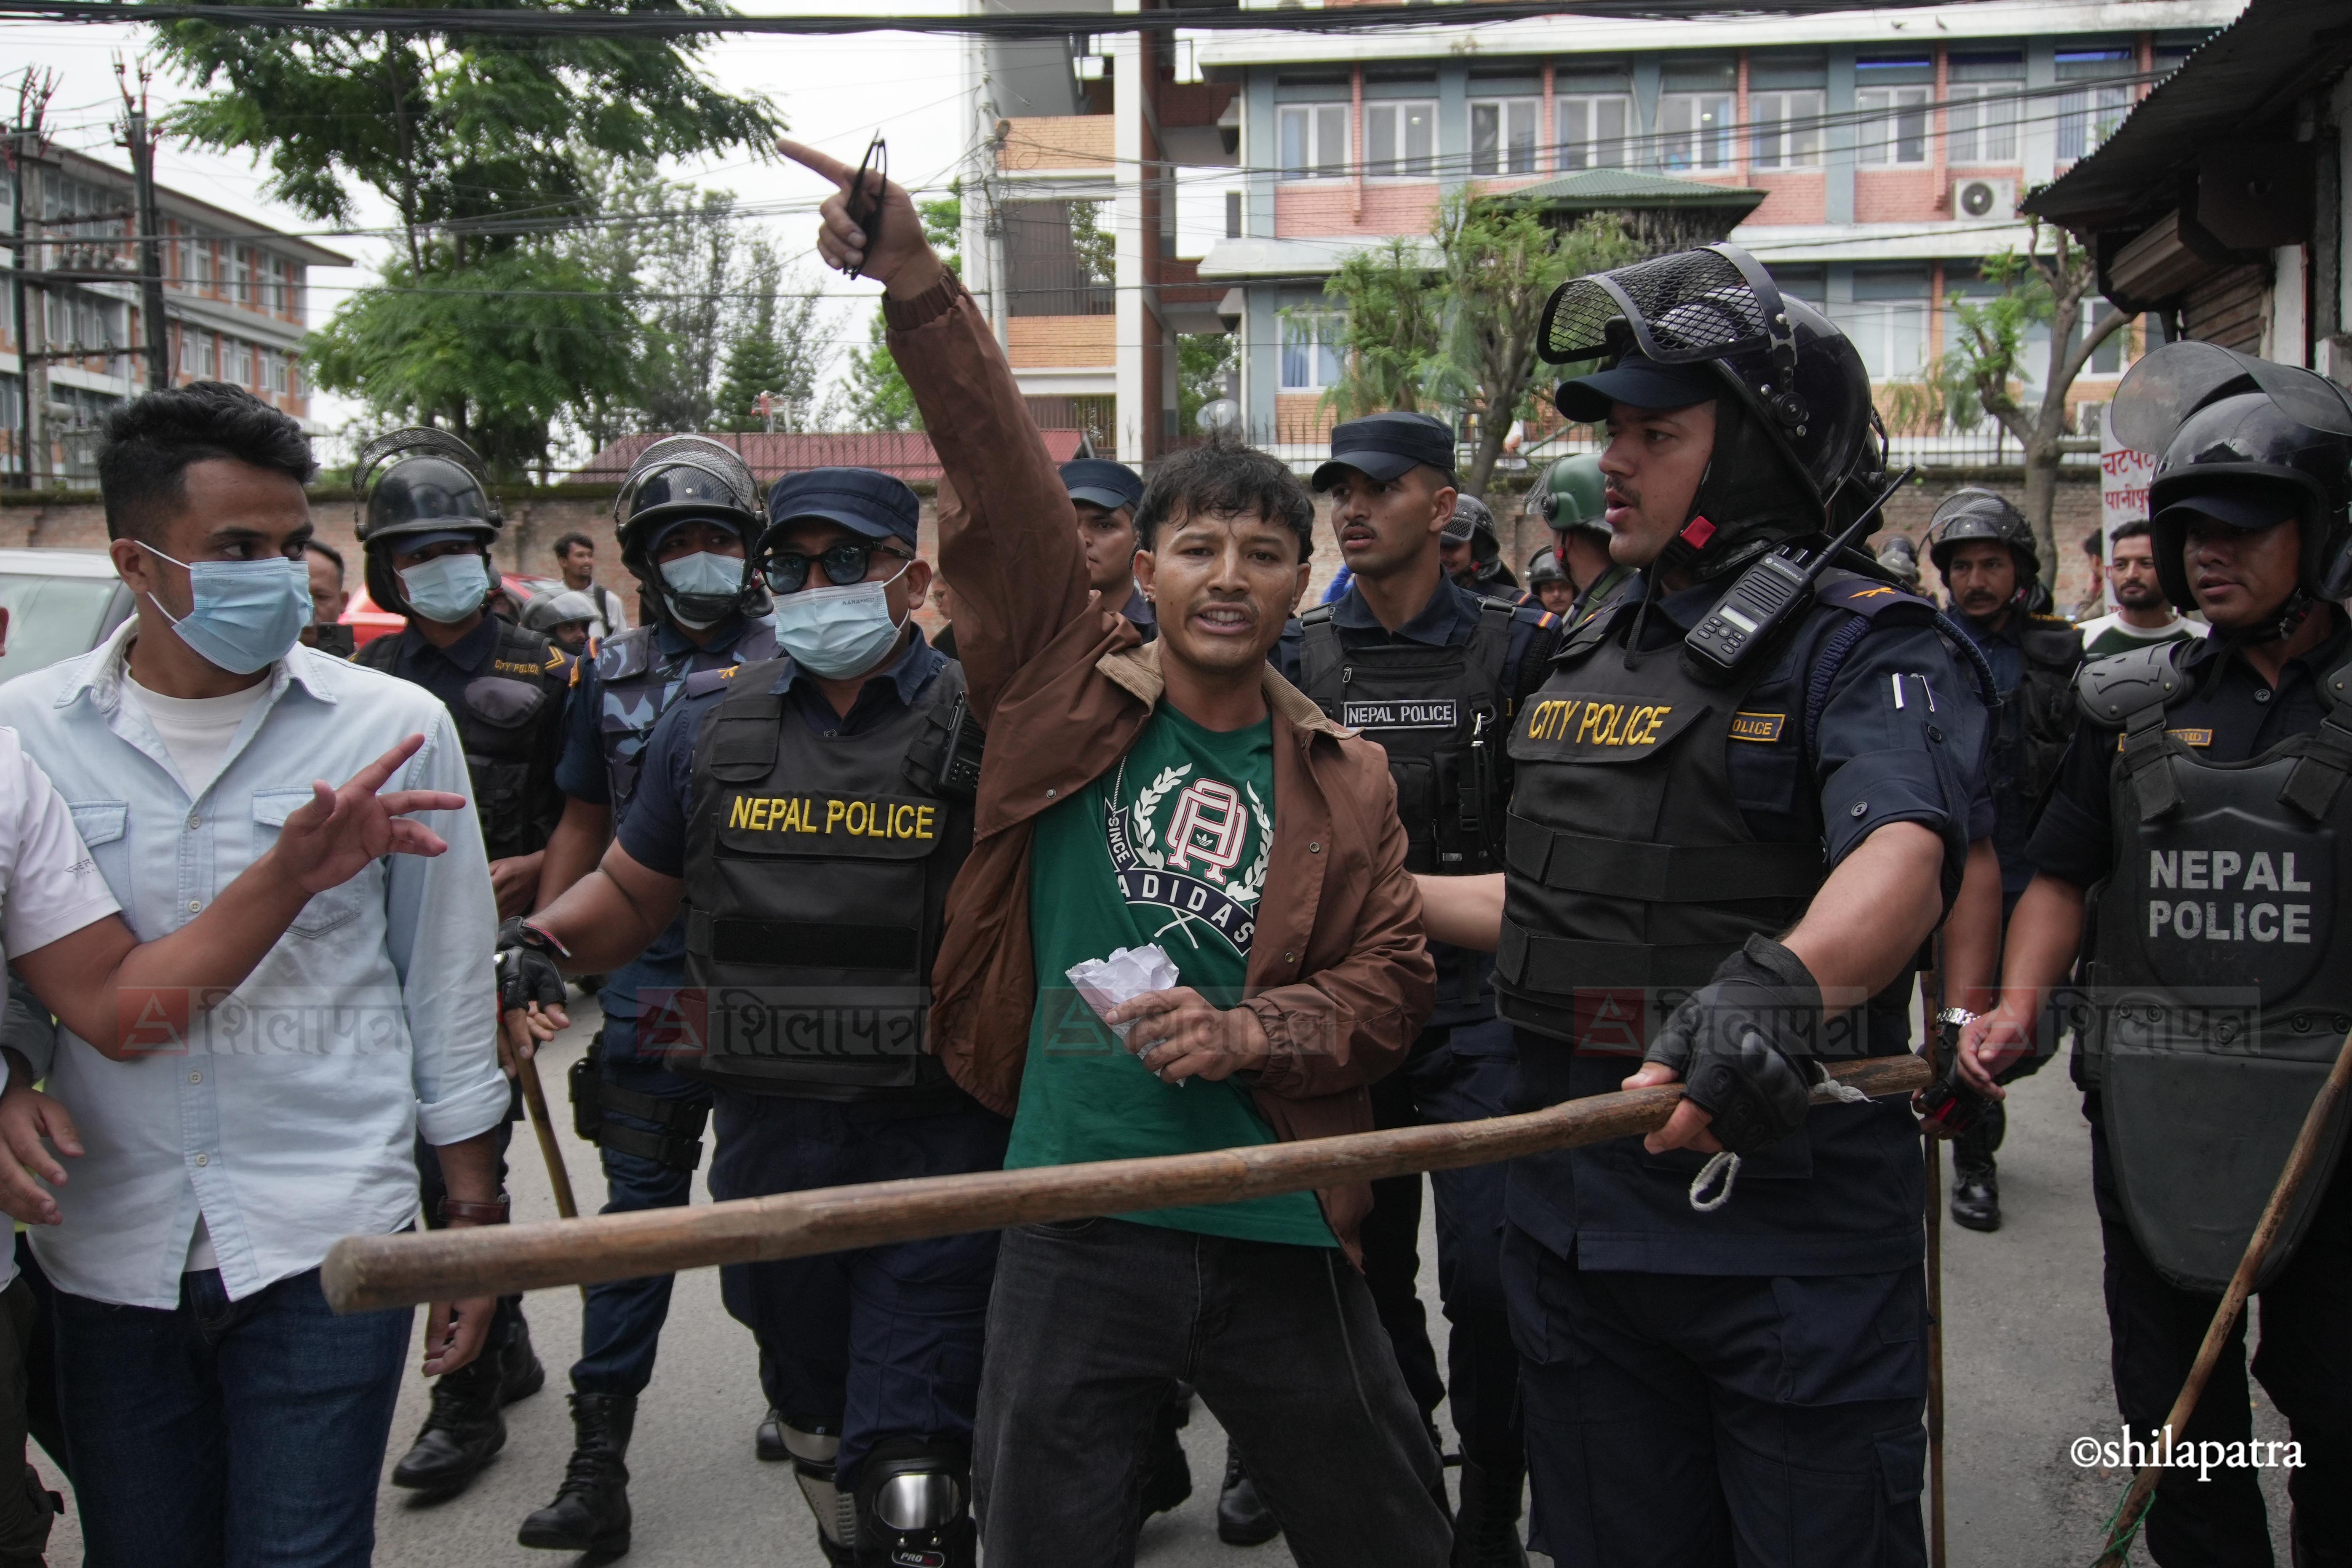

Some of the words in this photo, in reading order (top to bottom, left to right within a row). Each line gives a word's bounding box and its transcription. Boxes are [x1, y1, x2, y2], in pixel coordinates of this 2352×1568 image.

[1773, 562, 1802, 582] MOTOROLA
[495, 660, 511, 671] CITY
[513, 663, 539, 675] POLICE
[1348, 707, 1395, 724] NEPAL
[1400, 705, 1452, 722] POLICE
[1528, 700, 1582, 740] CITY
[1575, 702, 1672, 745] POLICE
[1732, 719, 1773, 735] OLICE
[729, 796, 817, 833] NEPAL
[825, 799, 934, 839] POLICE
[1108, 817, 1131, 863] SINCE
[2150, 850, 2311, 892] NEPAL
[1117, 873, 1255, 943] ADIDAS
[2149, 900, 2311, 943] POLICE
